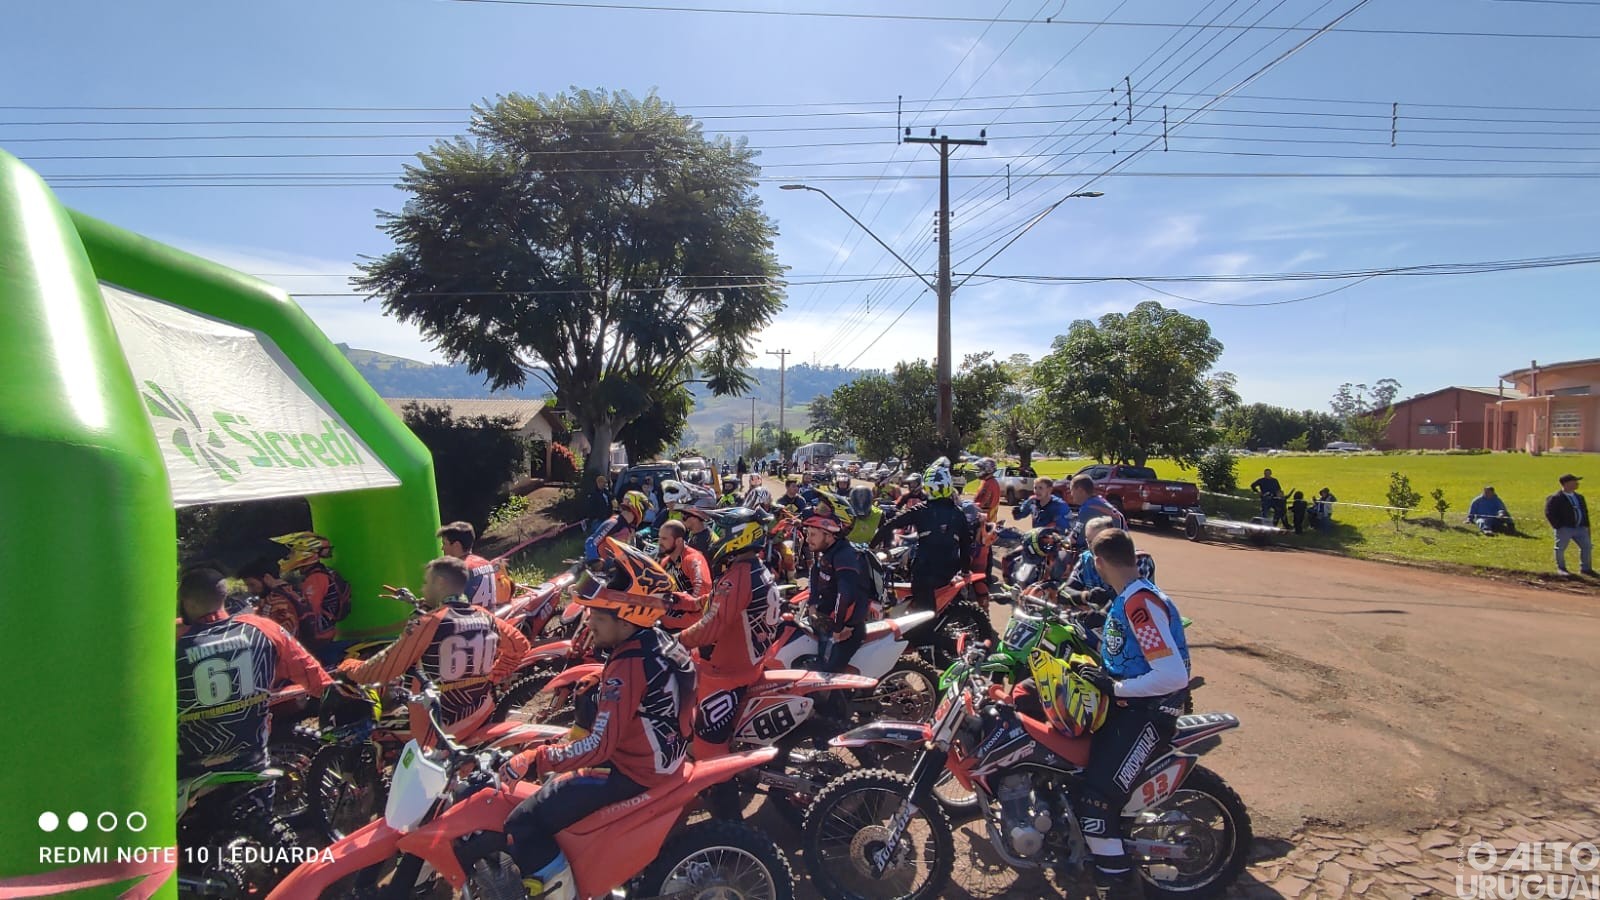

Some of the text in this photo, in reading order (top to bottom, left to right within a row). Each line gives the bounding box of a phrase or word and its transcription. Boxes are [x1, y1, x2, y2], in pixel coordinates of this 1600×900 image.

[212, 411, 364, 468] Sicredi
[193, 649, 254, 706] 61
[753, 704, 796, 740] 88
[983, 728, 1005, 752] HONDA
[1142, 773, 1168, 804] 93
[875, 807, 910, 873] DUNLOP
